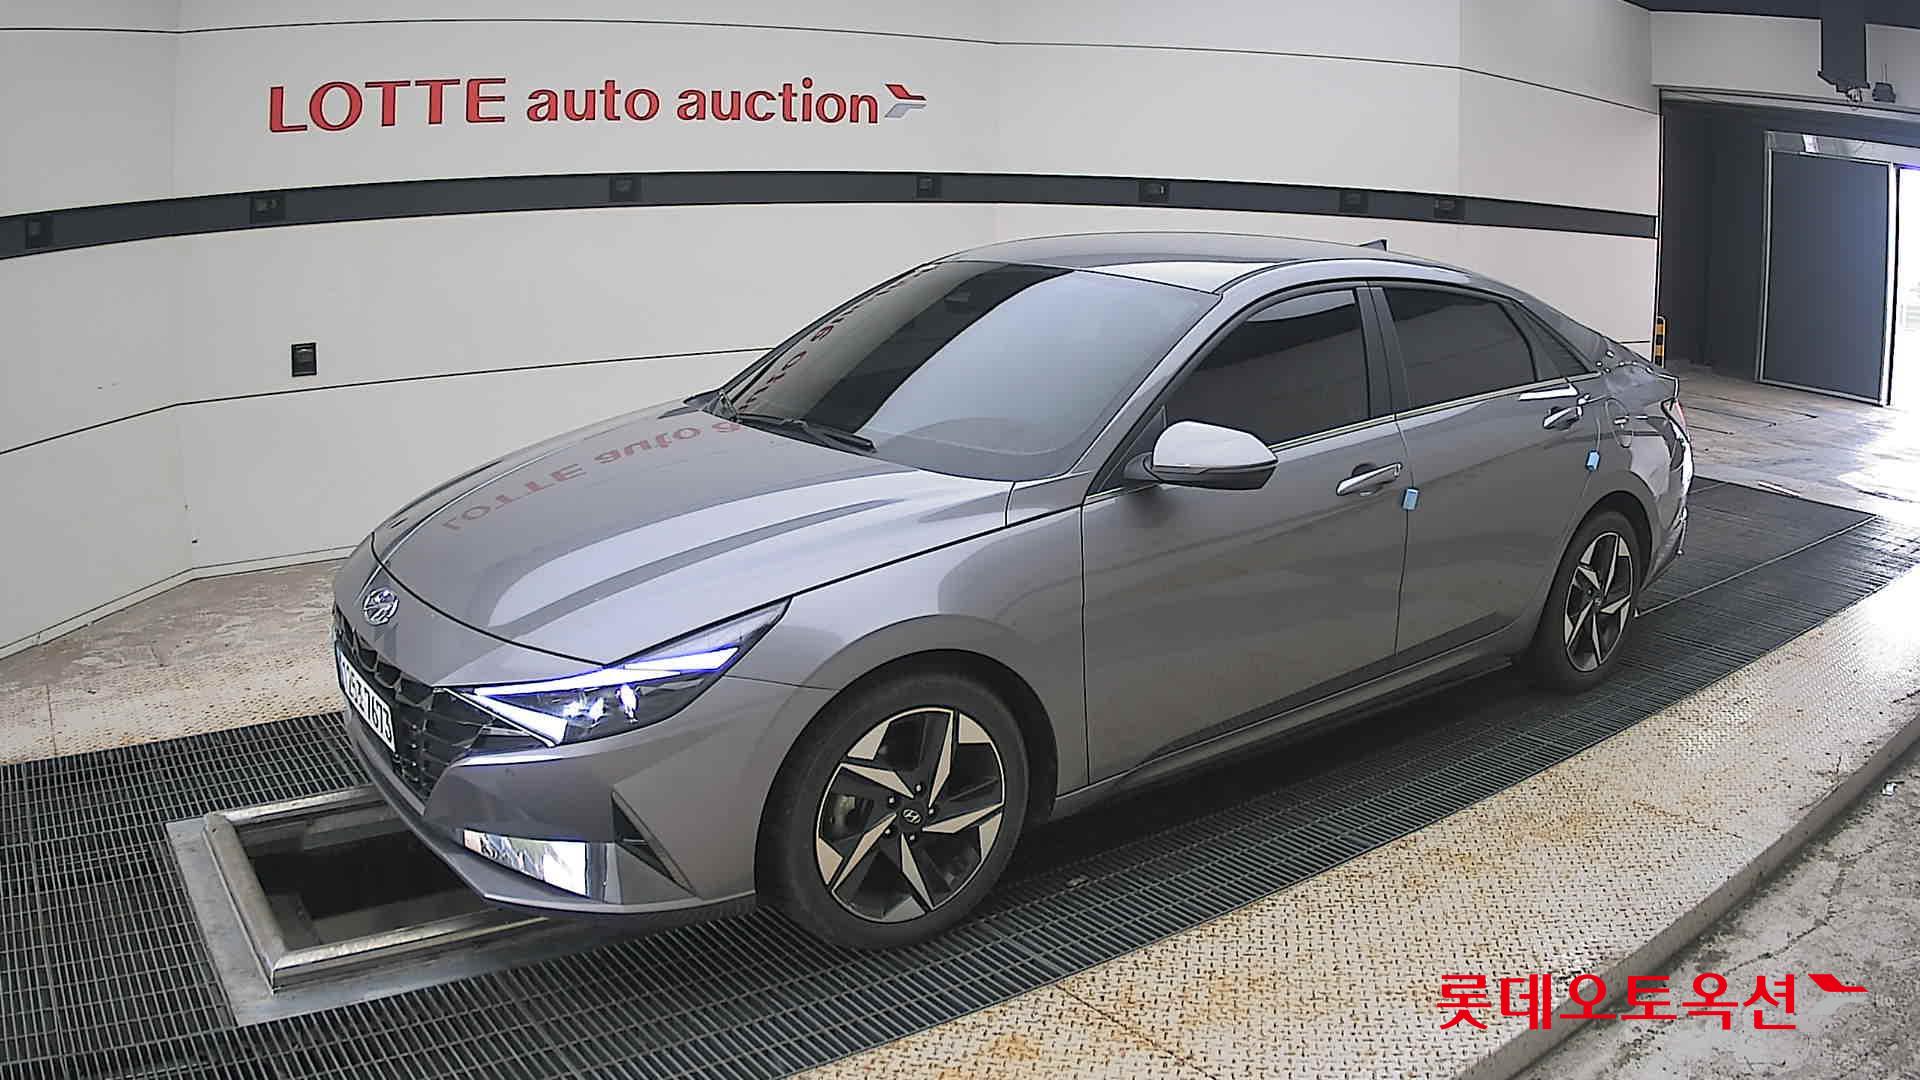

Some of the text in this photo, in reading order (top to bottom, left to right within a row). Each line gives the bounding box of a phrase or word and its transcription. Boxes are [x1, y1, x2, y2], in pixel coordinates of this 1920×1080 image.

[268, 77, 880, 133] LOTTE auto auction
